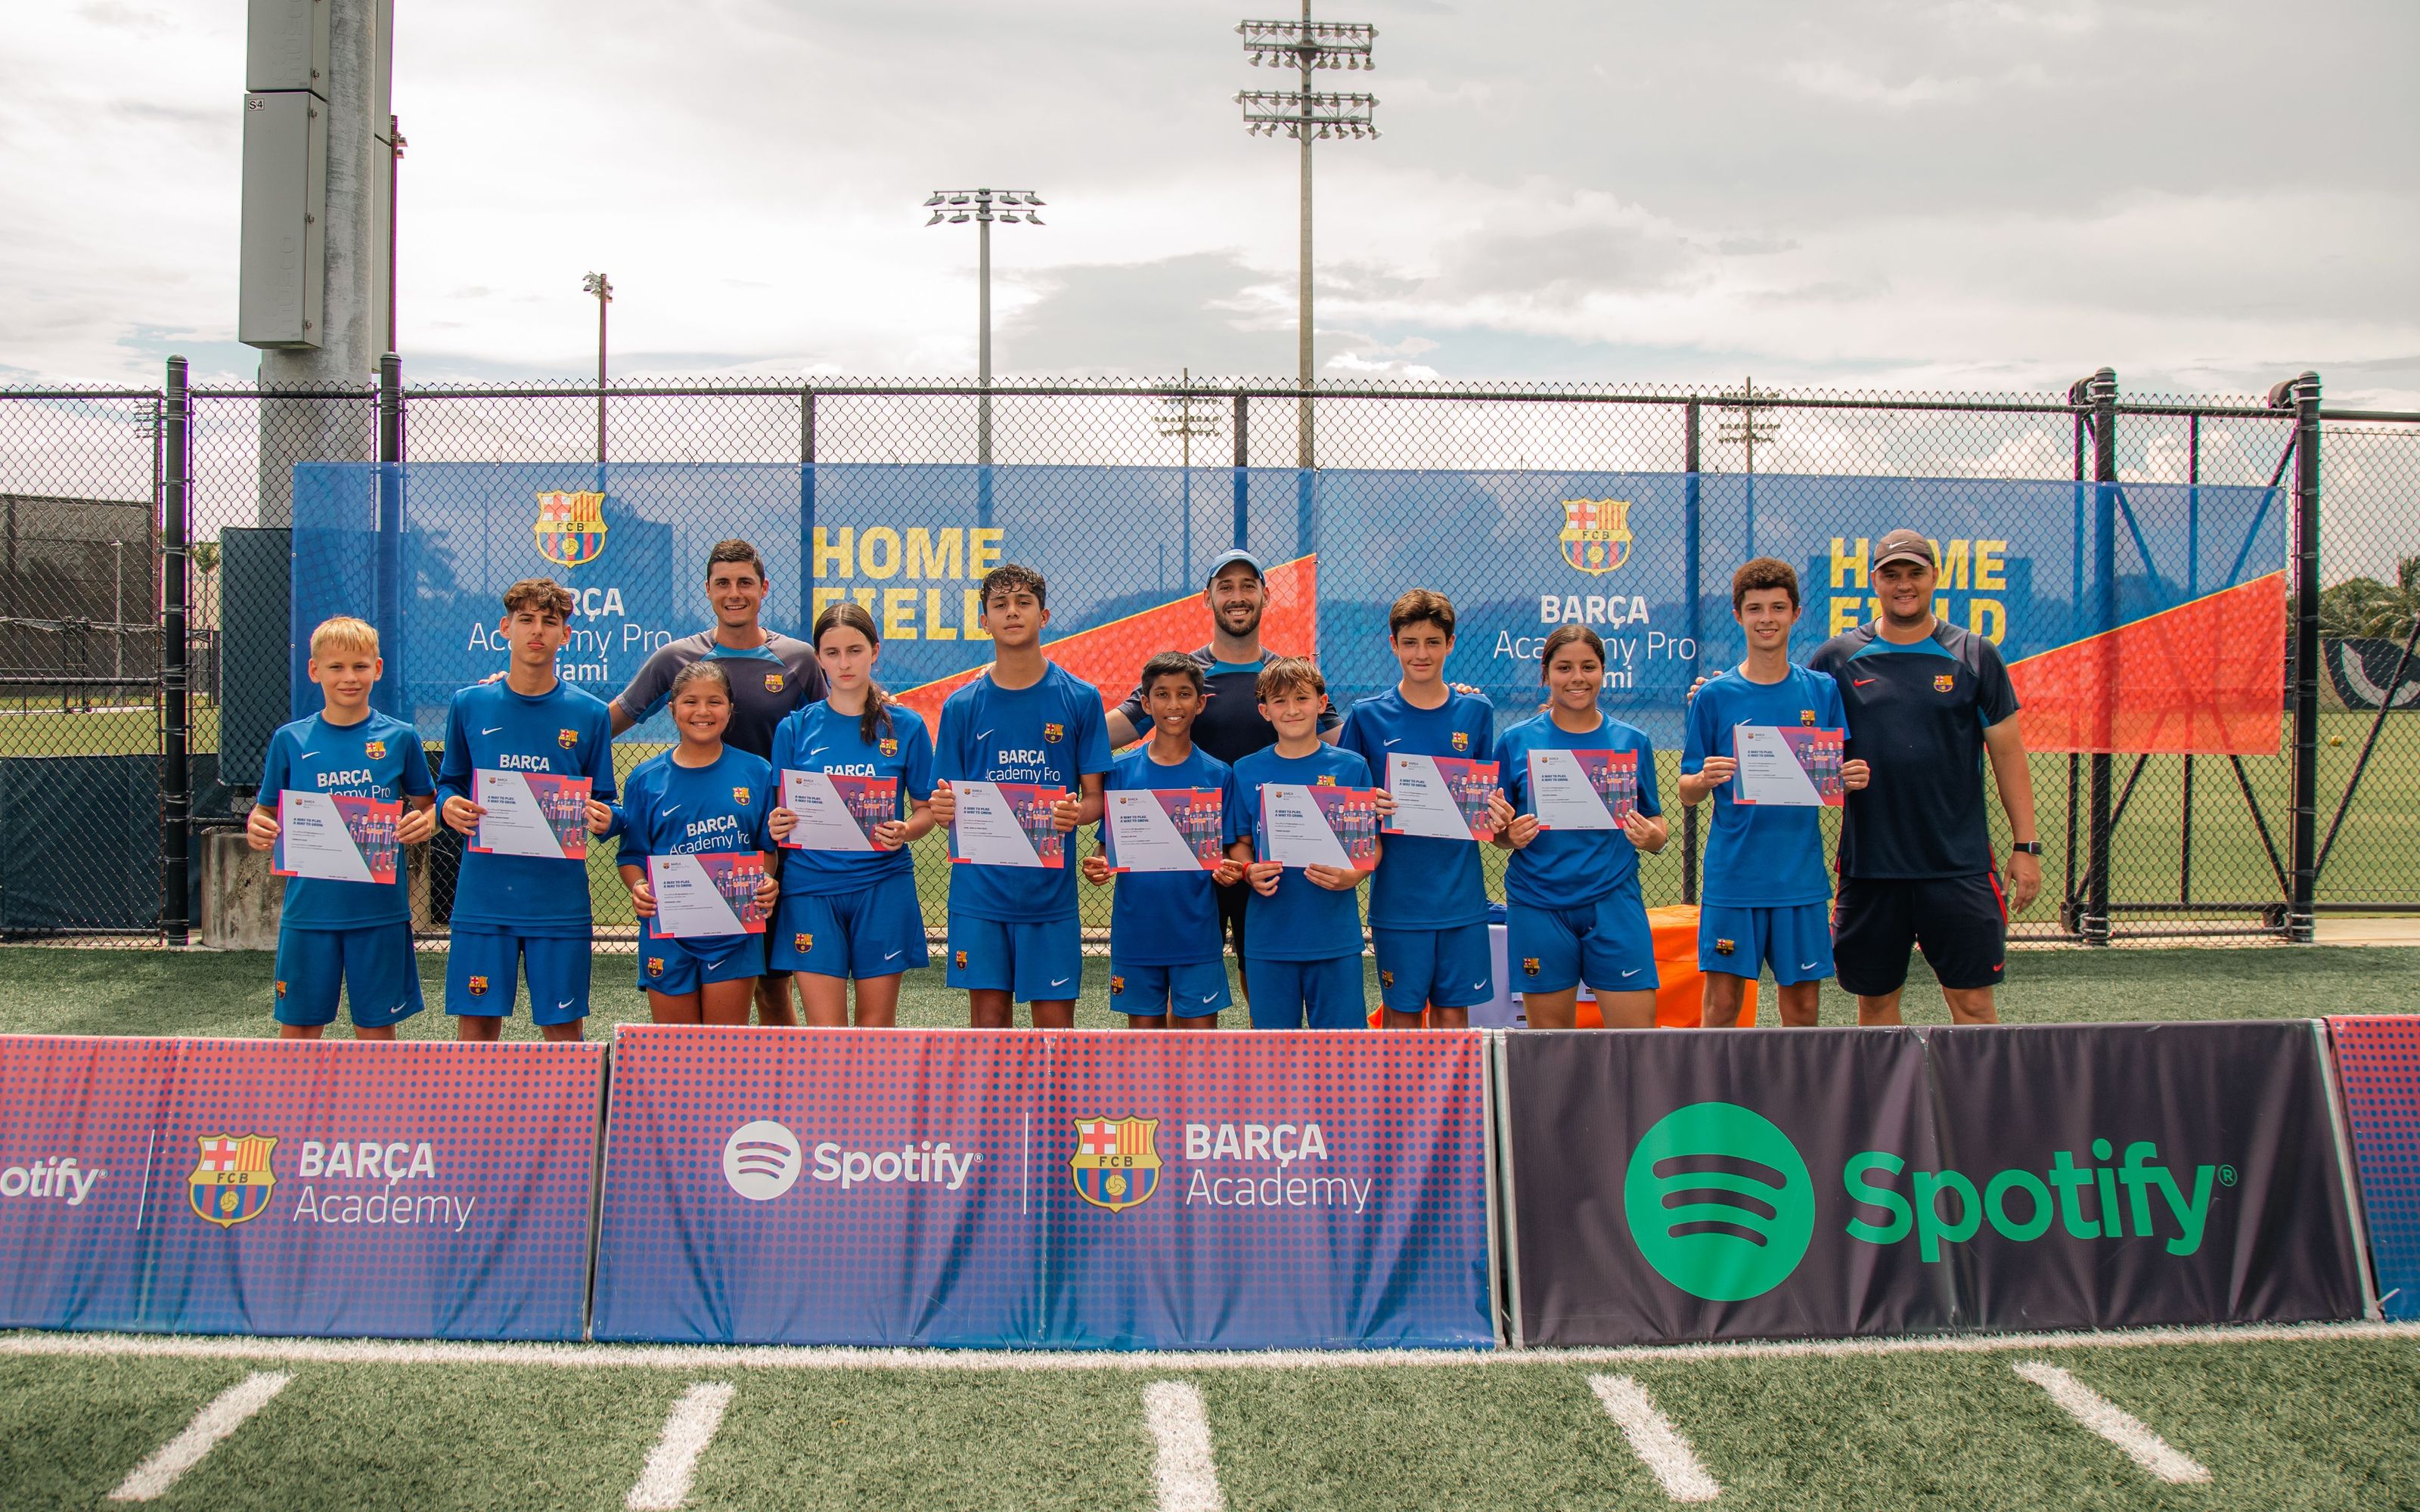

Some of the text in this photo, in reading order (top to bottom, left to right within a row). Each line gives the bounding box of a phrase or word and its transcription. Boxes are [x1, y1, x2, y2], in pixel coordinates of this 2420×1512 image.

[250, 101, 262, 110] S4
[557, 522, 585, 532] FCB
[1582, 531, 1610, 540] FCB
[813, 527, 1004, 580] HOME
[1830, 538, 2007, 590] HME
[1540, 595, 1649, 629] BARÇA
[468, 622, 672, 658] Acmy Pro
[1648, 631, 1696, 660] Pro
[556, 658, 608, 681] iami
[500, 754, 550, 772] BARÇA
[999, 749, 1045, 767] BARÇA
[317, 769, 373, 787] BARÇA
[371, 785, 391, 798] Pro
[687, 815, 738, 837] BARÇA
[669, 836, 733, 856] Academy
[1186, 1124, 1327, 1167] BARÇA
[299, 1142, 436, 1185] BARÇA
[1100, 1156, 1134, 1167] FCB
[217, 1173, 249, 1185] FCB
[1186, 1167, 1372, 1214] Academy
[293, 1184, 476, 1232] Academy
